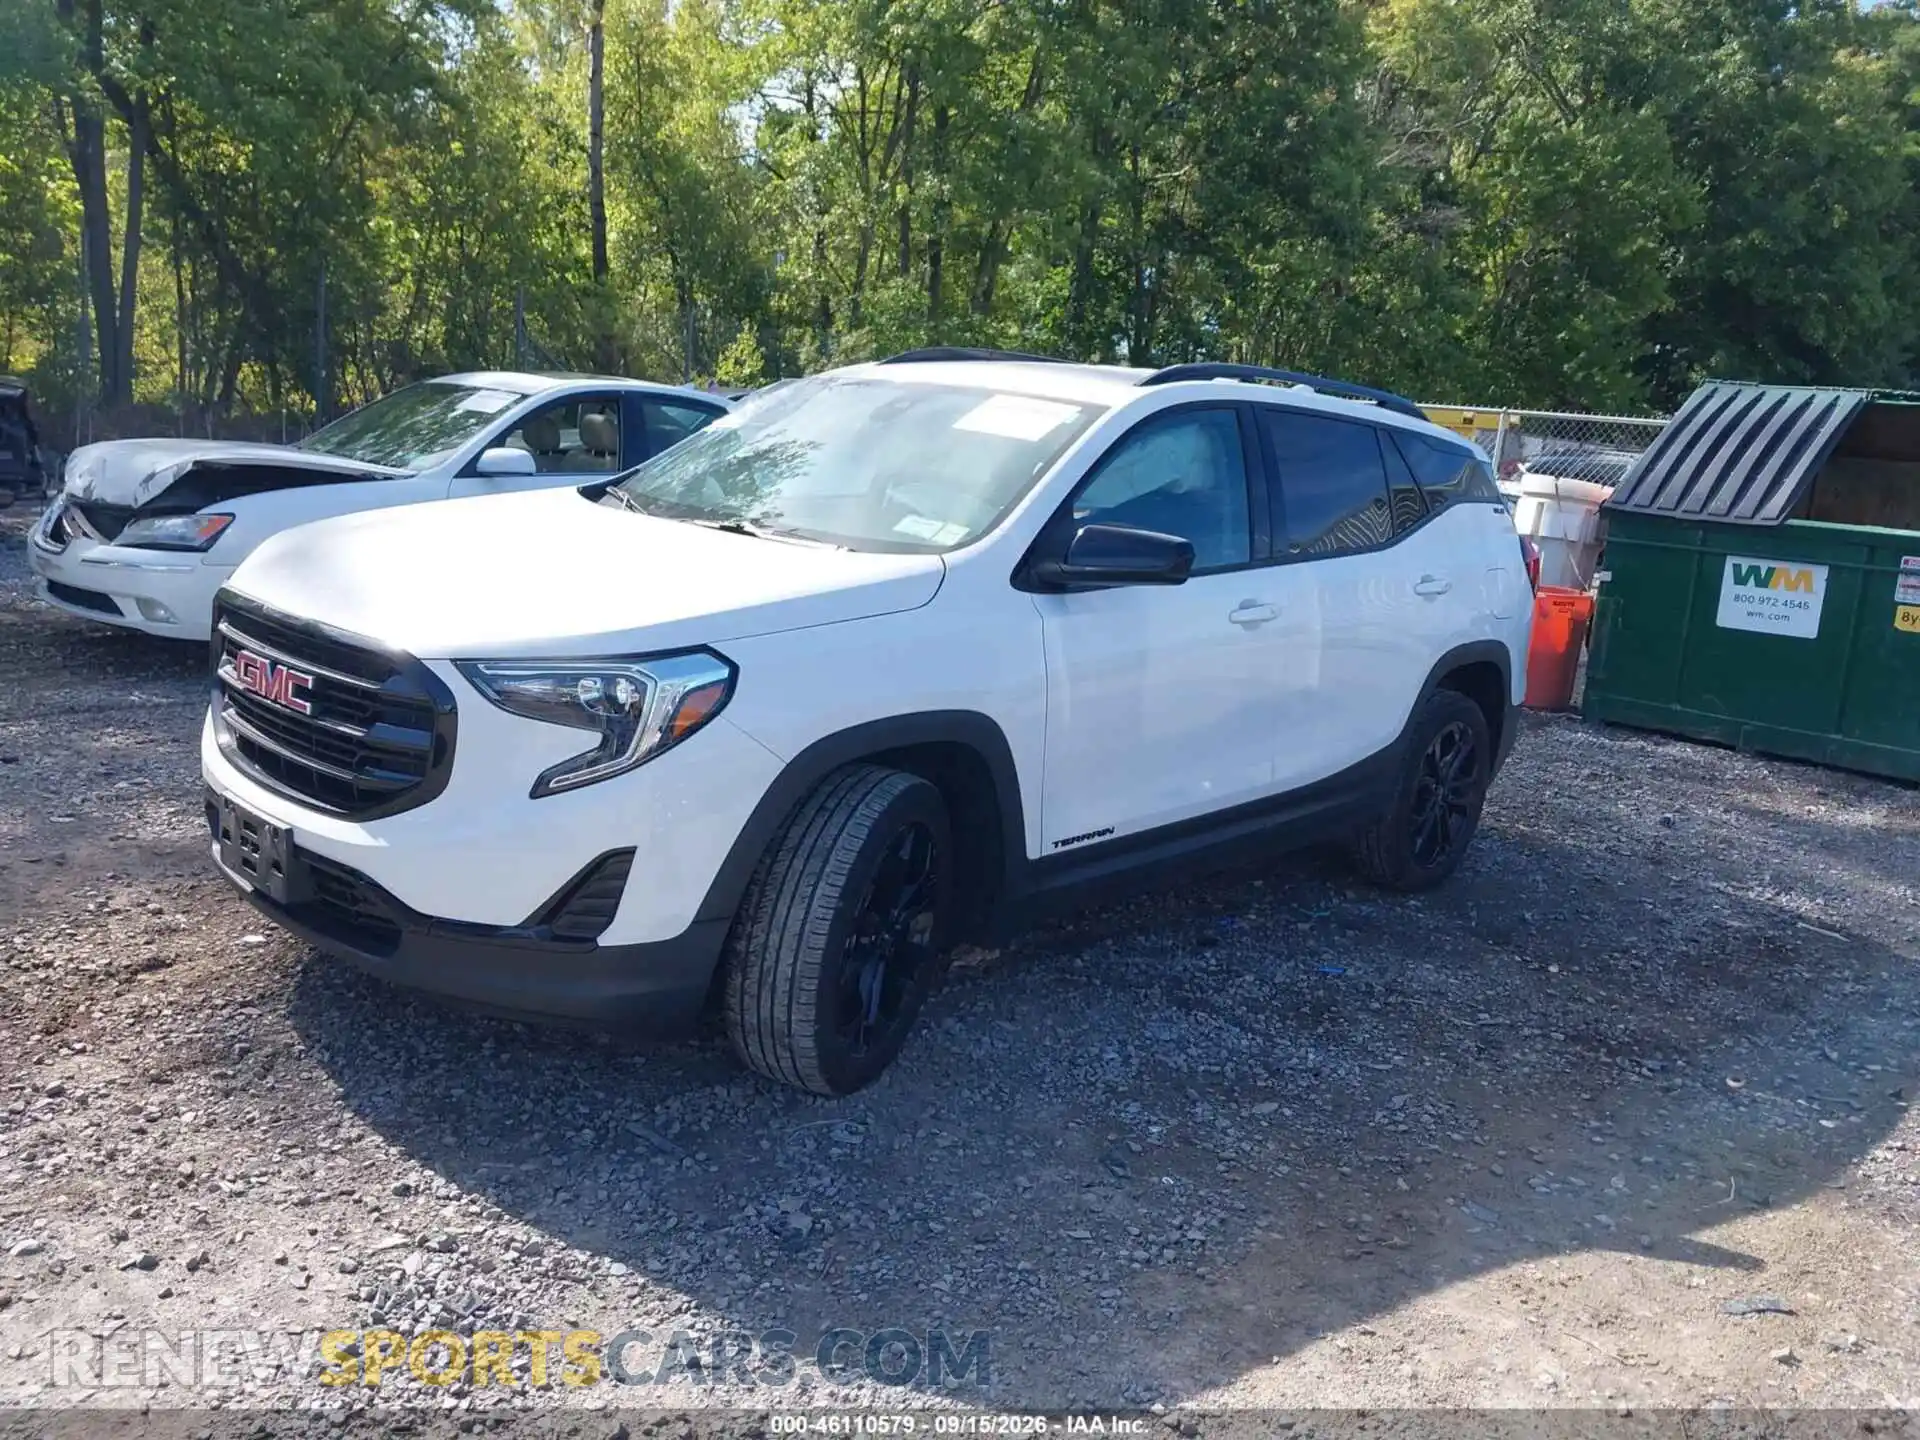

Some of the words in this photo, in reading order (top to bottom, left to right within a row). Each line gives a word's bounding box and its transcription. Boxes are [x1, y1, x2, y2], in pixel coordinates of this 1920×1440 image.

[1732, 563, 1815, 593] WM
[1734, 593, 1755, 604] 800
[1758, 595, 1778, 607] 972
[1902, 611, 1920, 625] 8y
[236, 650, 315, 715] GMC
[1052, 826, 1115, 848] TERRAIN
